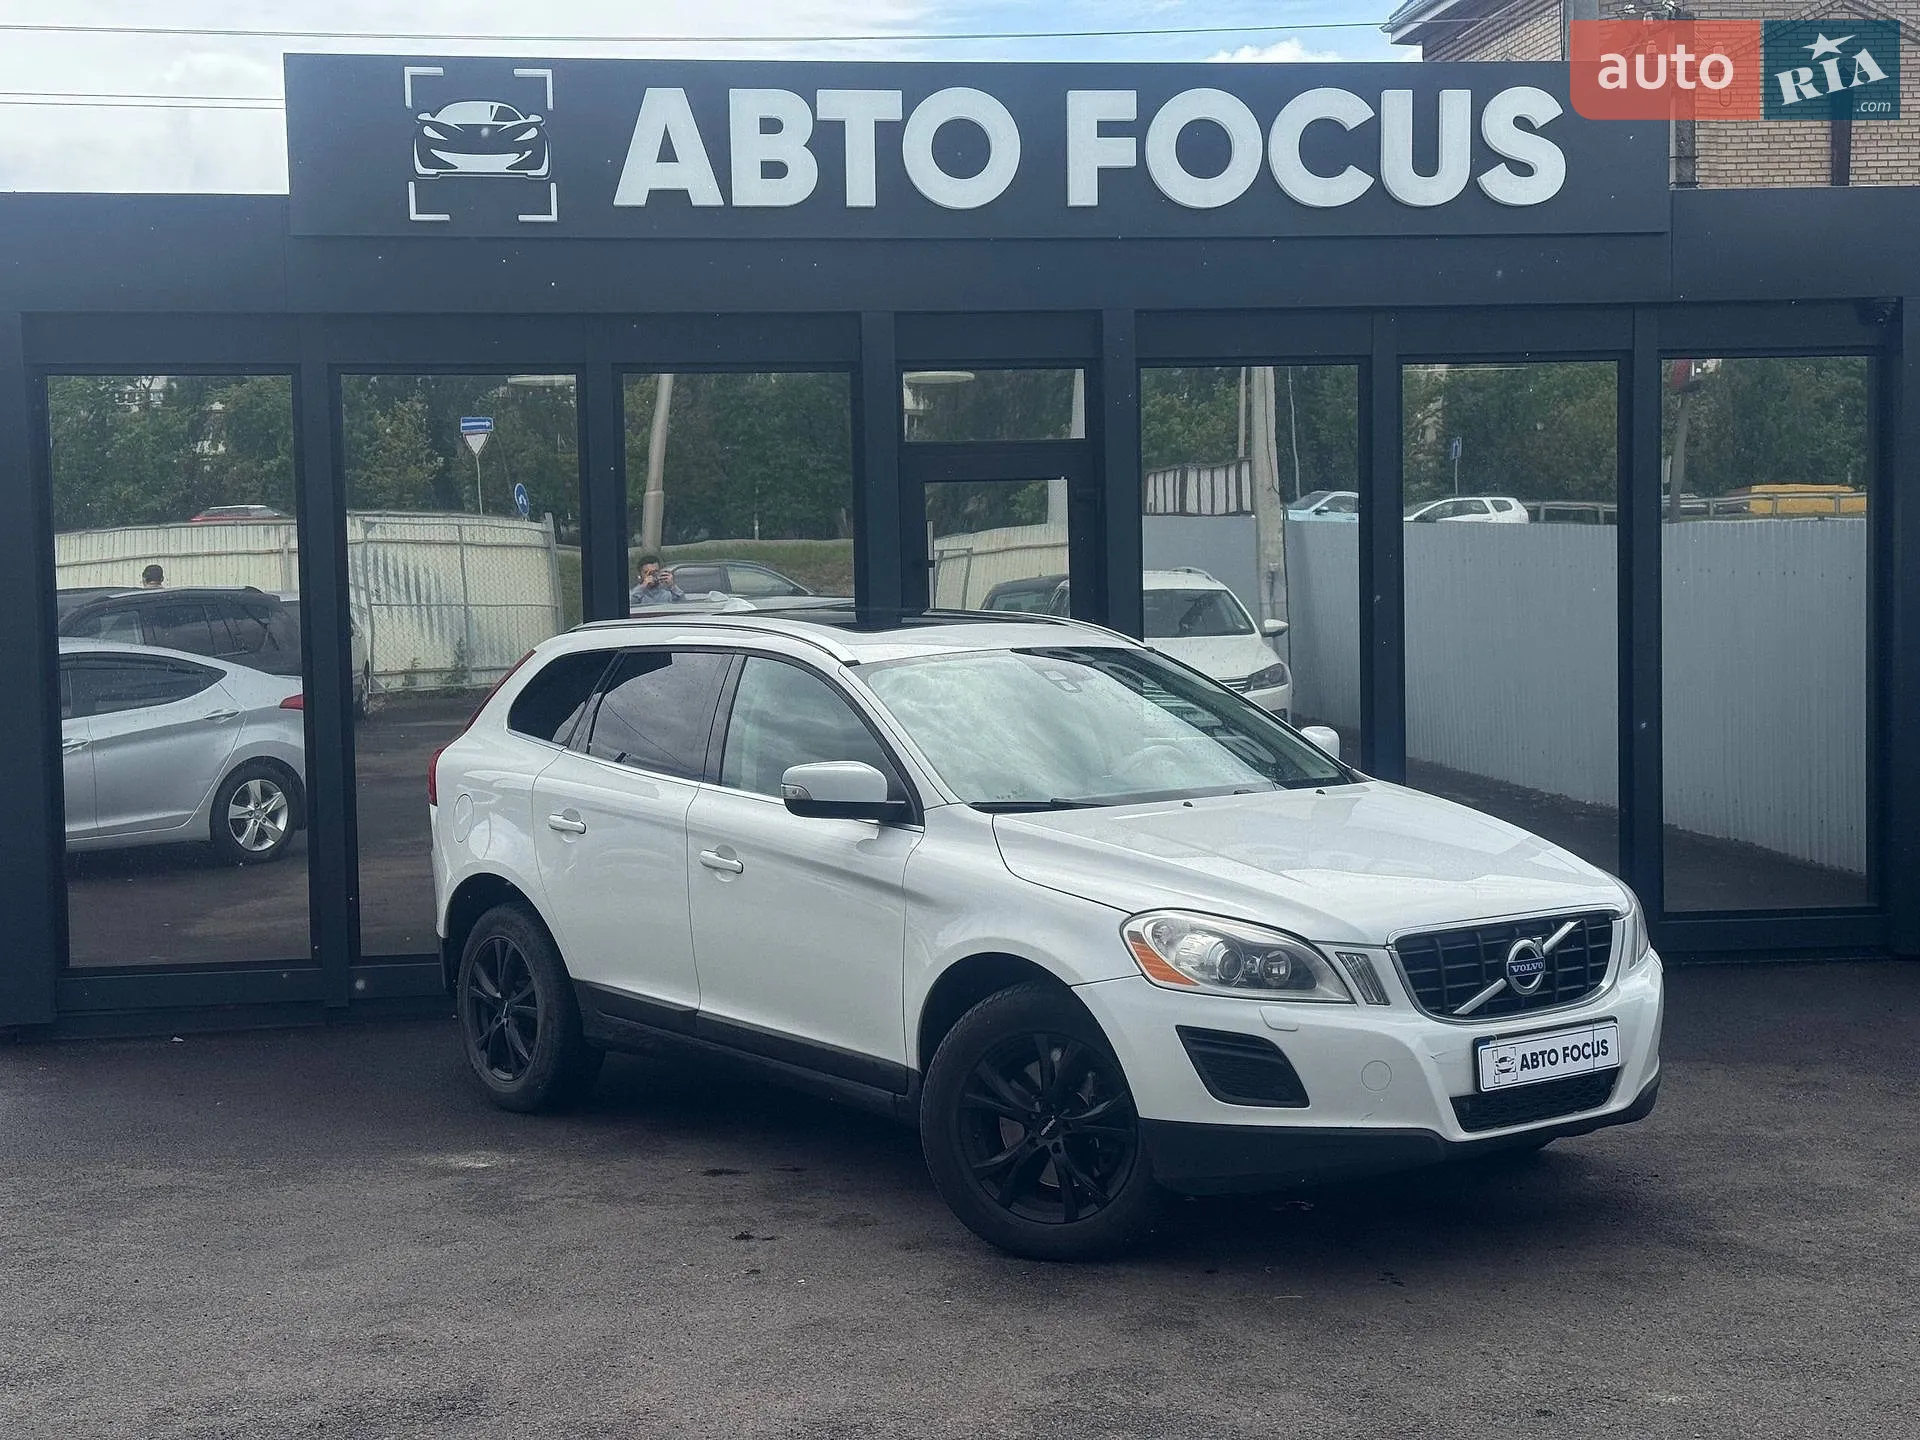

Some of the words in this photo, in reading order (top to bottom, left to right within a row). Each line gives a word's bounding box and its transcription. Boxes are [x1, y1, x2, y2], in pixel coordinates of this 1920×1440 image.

[613, 86, 1021, 209] АВТО
[1066, 86, 1566, 208] FOCUS
[1511, 961, 1543, 973] VOLVO
[1562, 1039, 1609, 1064] FOCUS
